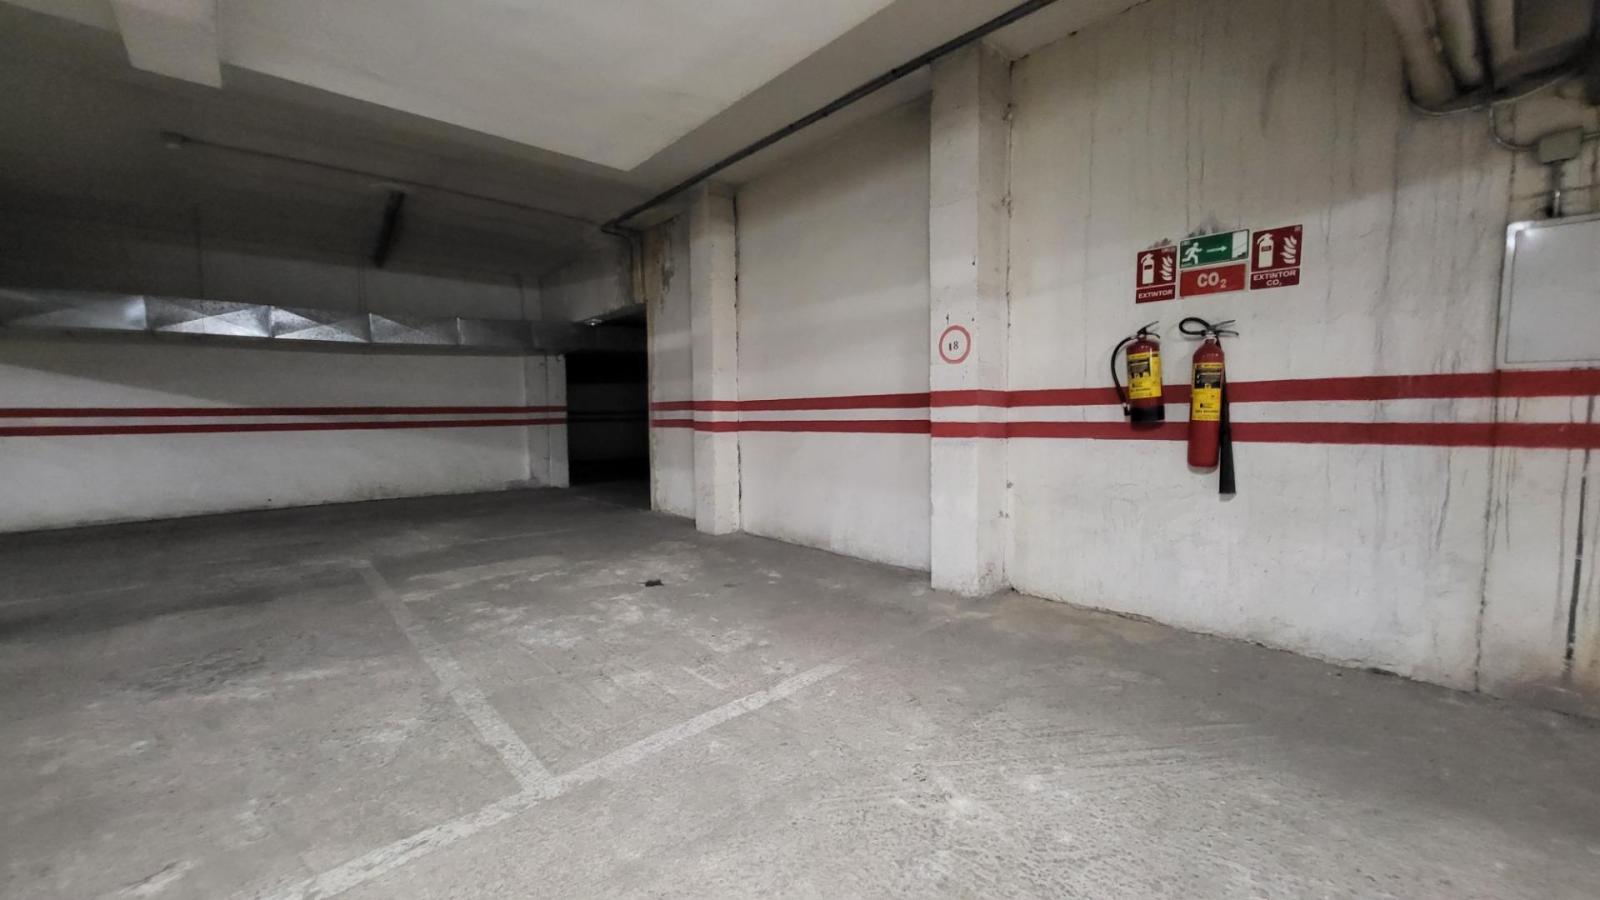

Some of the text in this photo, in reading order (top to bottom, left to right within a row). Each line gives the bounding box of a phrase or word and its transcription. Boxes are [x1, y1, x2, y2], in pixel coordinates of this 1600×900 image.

[1253, 270, 1296, 281] EXTINTOR
[1138, 289, 1173, 299] EXTINTOR
[949, 341, 959, 351] 18
